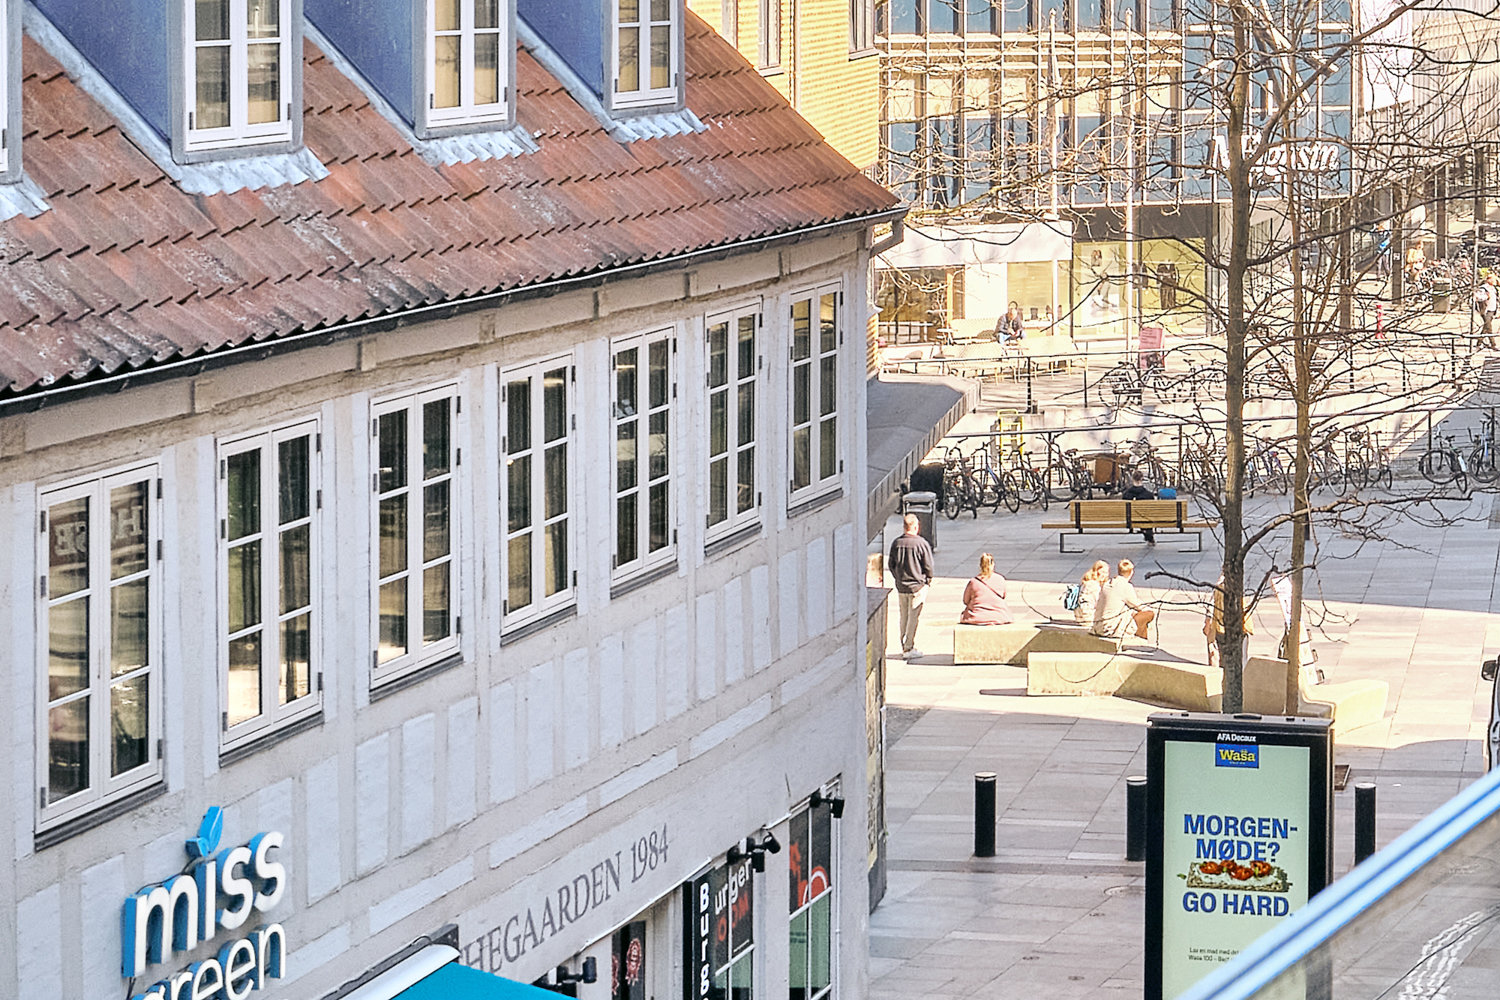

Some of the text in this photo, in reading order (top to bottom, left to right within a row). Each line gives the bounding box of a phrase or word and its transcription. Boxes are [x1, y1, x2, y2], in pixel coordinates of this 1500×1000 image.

[1219, 749, 1255, 761] Wasa
[1184, 814, 1298, 839] MORGEN-
[631, 823, 669, 884] 1984
[1196, 839, 1281, 863] MØDE?
[124, 829, 287, 977] miss
[714, 858, 752, 915] urger
[1182, 891, 1293, 917] GO HARD.
[699, 882, 710, 1000] Burg
